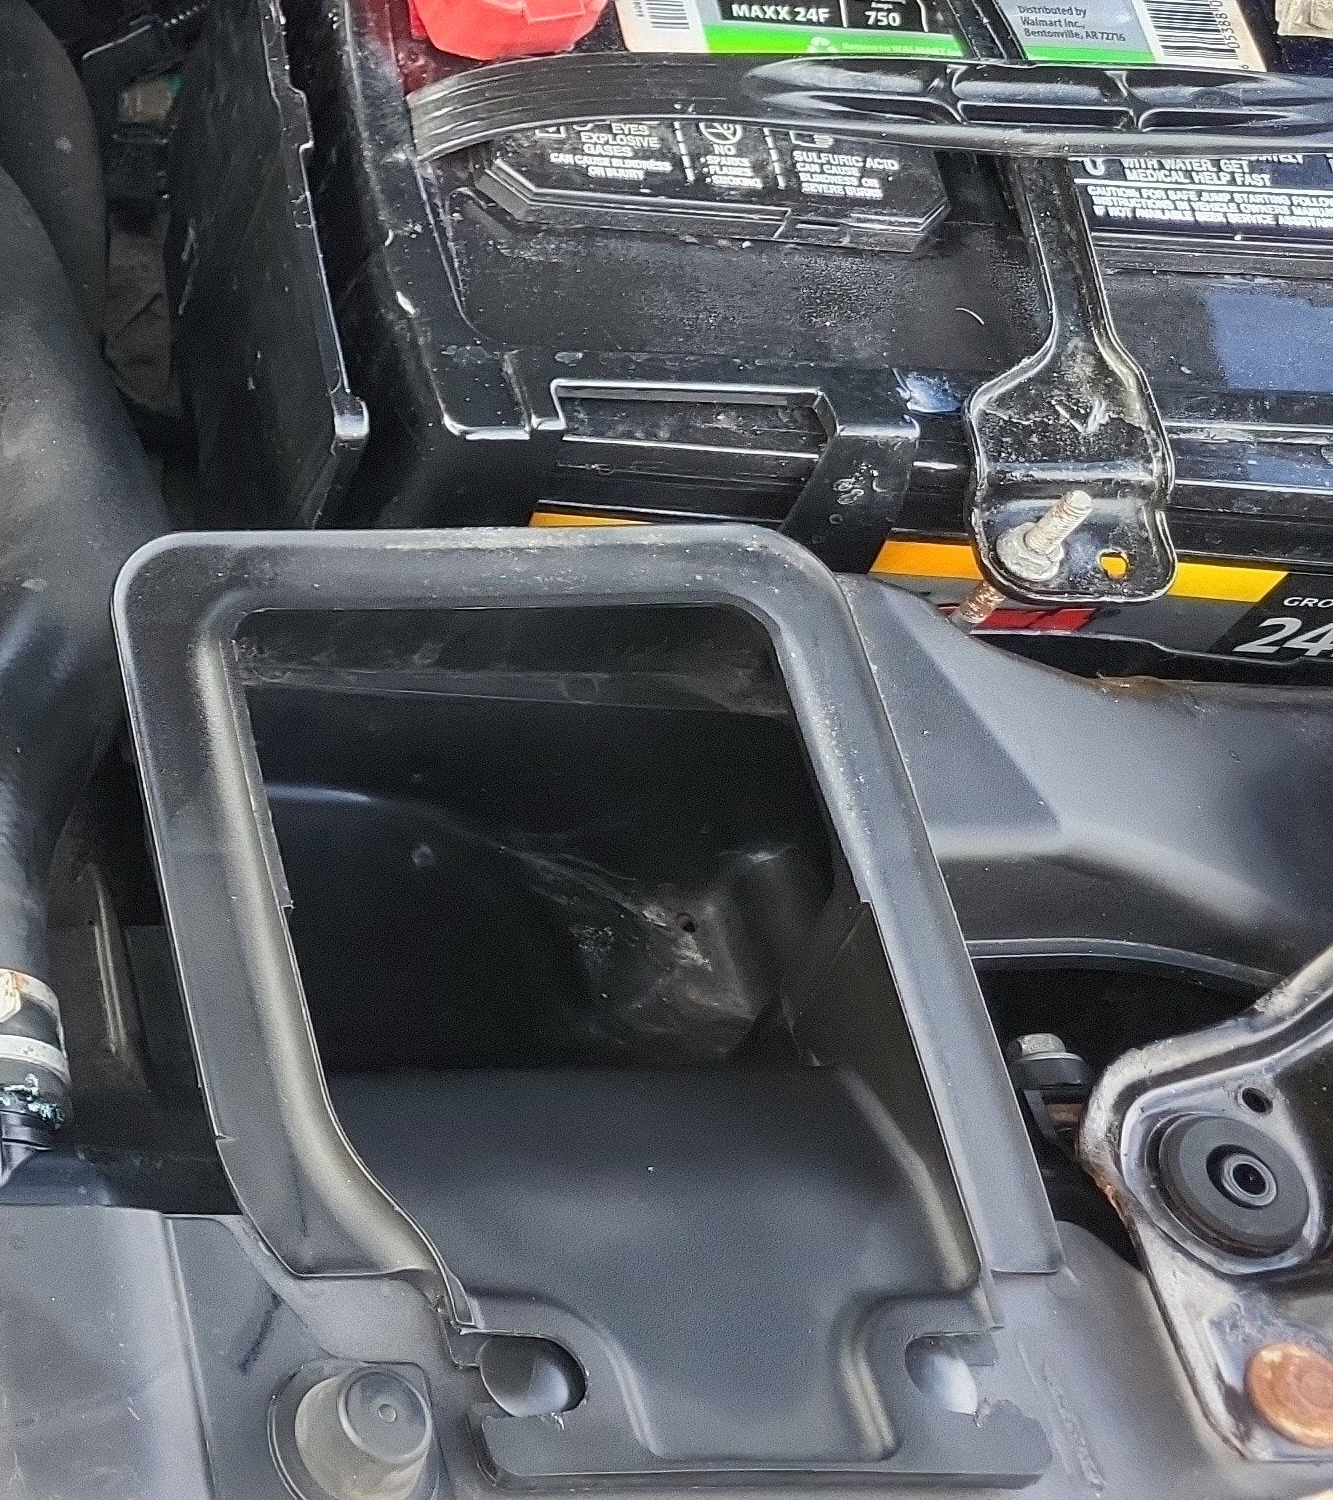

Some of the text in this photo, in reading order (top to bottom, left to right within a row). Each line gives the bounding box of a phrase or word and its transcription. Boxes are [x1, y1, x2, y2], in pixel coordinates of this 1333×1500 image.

[730, 4, 831, 23] MAXX 24F
[864, 10, 902, 27] 750
[1017, 5, 1087, 19] Distributed by
[1020, 16, 1063, 28] Walmart
[1024, 27, 1084, 41] Bentonville,
[1085, 30, 1099, 40] AR
[611, 122, 650, 136] EYES
[580, 132, 661, 149] EXPLOSIVE
[583, 143, 634, 157] GASES
[714, 144, 734, 156] NO
[550, 152, 574, 165] CAN
[793, 151, 899, 171] SULFURIC ACID
[1121, 158, 1160, 170] WITH
[1219, 158, 1251, 173] GET
[796, 162, 821, 174] CAN
[1125, 169, 1271, 187] MEDICAL HELP FAST
[1142, 187, 1167, 201] FOR
[1168, 189, 1199, 202] SAFE
[1199, 191, 1232, 204] JUMP
[1233, 192, 1291, 207] STARTING
[1108, 206, 1134, 218] NOT
[1191, 199, 1240, 214] VEHICLE
